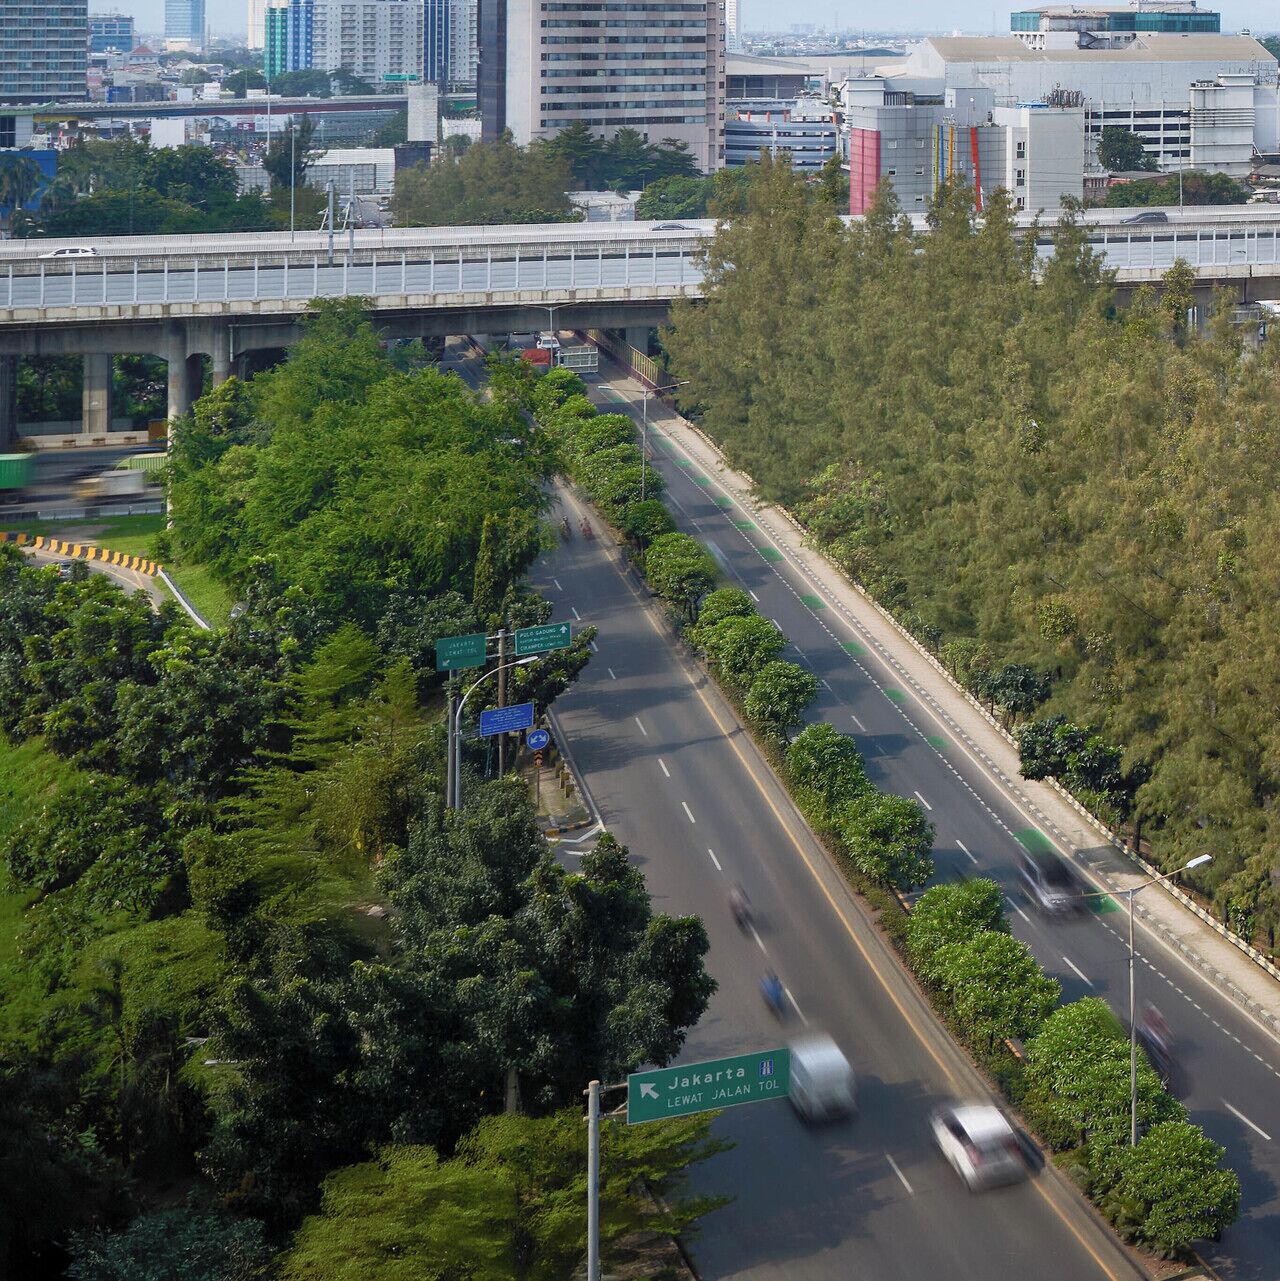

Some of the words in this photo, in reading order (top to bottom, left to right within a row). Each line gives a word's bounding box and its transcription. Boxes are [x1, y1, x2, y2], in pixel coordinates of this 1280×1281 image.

[449, 640, 475, 649] JAKARTA
[668, 1067, 746, 1090] Jakarta
[667, 1092, 704, 1108] LEWAT
[711, 1084, 751, 1100] JALAN
[758, 1080, 780, 1092] TOL
